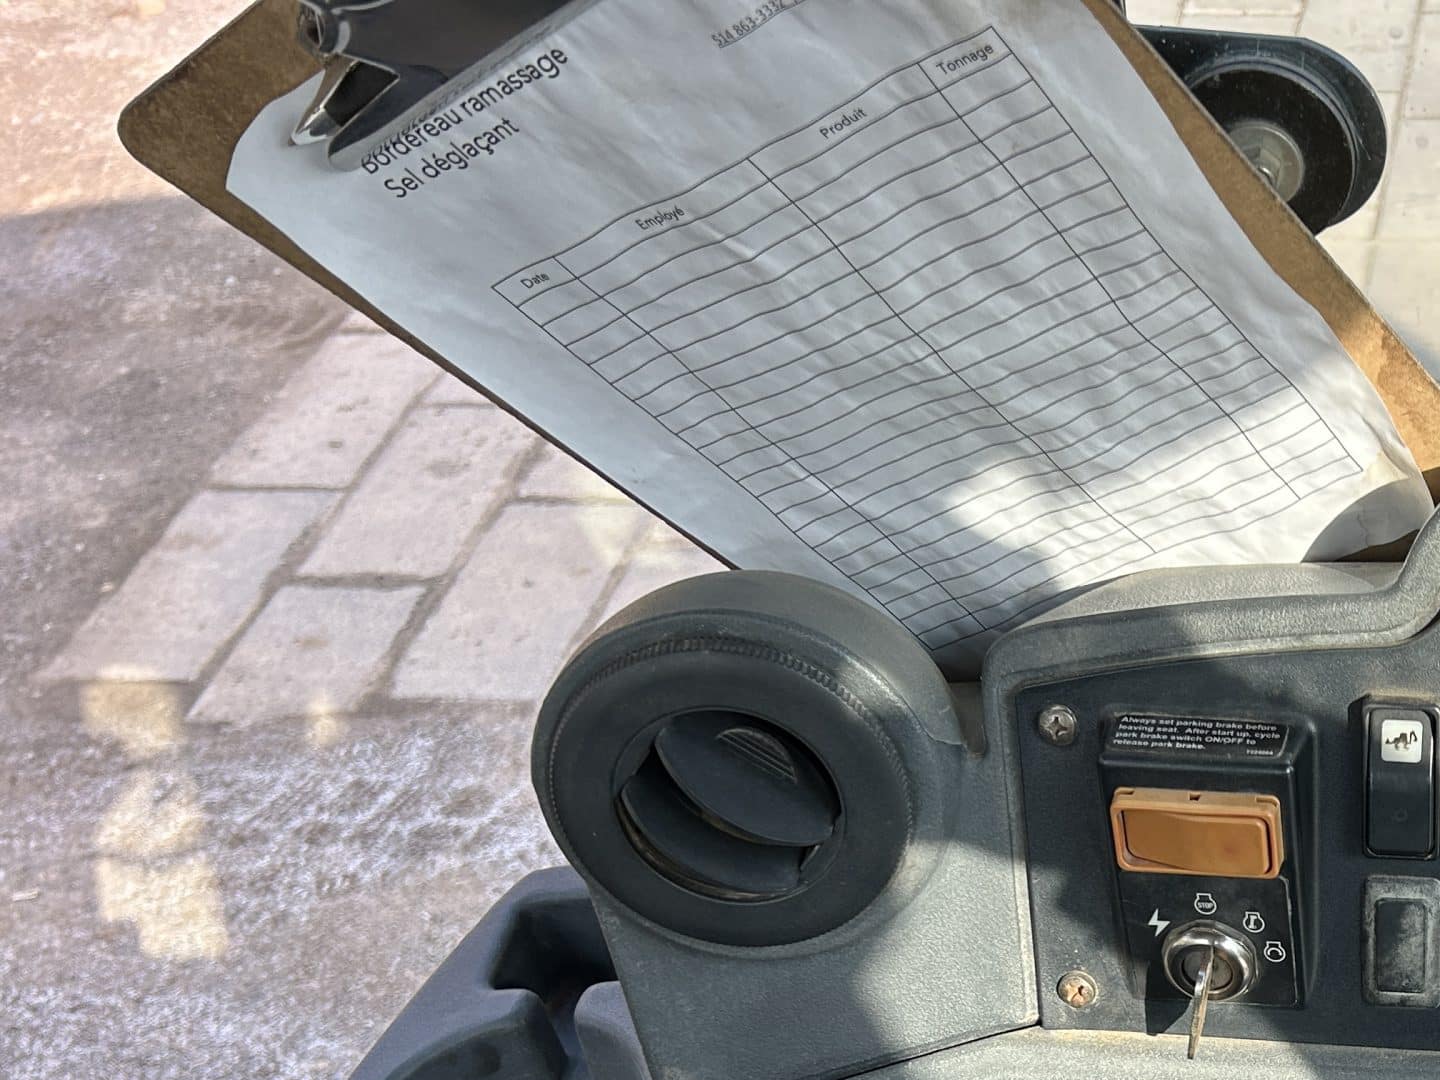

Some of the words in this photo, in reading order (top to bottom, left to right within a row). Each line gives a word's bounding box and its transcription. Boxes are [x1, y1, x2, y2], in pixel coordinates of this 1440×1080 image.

[935, 43, 994, 76] Tonnage
[361, 107, 463, 175] Bordereau
[459, 48, 568, 118] ramassage
[819, 107, 868, 139] Produit
[384, 167, 424, 198] Sel
[421, 117, 520, 179] déglaçant
[635, 205, 686, 231] Employé
[520, 272, 550, 289] Date
[1118, 723, 1154, 733] leaving
[1185, 727, 1210, 735] After
[1211, 729, 1234, 737] start
[1254, 731, 1281, 740] cycle
[1120, 716, 1156, 725] Always
[1175, 719, 1213, 729] parking
[1215, 720, 1243, 730] brake
[1245, 722, 1277, 732] before
[1113, 738, 1149, 747] release
[1150, 740, 1173, 749] park
[1175, 741, 1206, 750] brake.
[1115, 730, 1138, 739] park
[1140, 732, 1168, 741] brake
[1170, 733, 1202, 742] switch
[1204, 736, 1244, 745] ON/OFF
[1246, 738, 1257, 746] to
